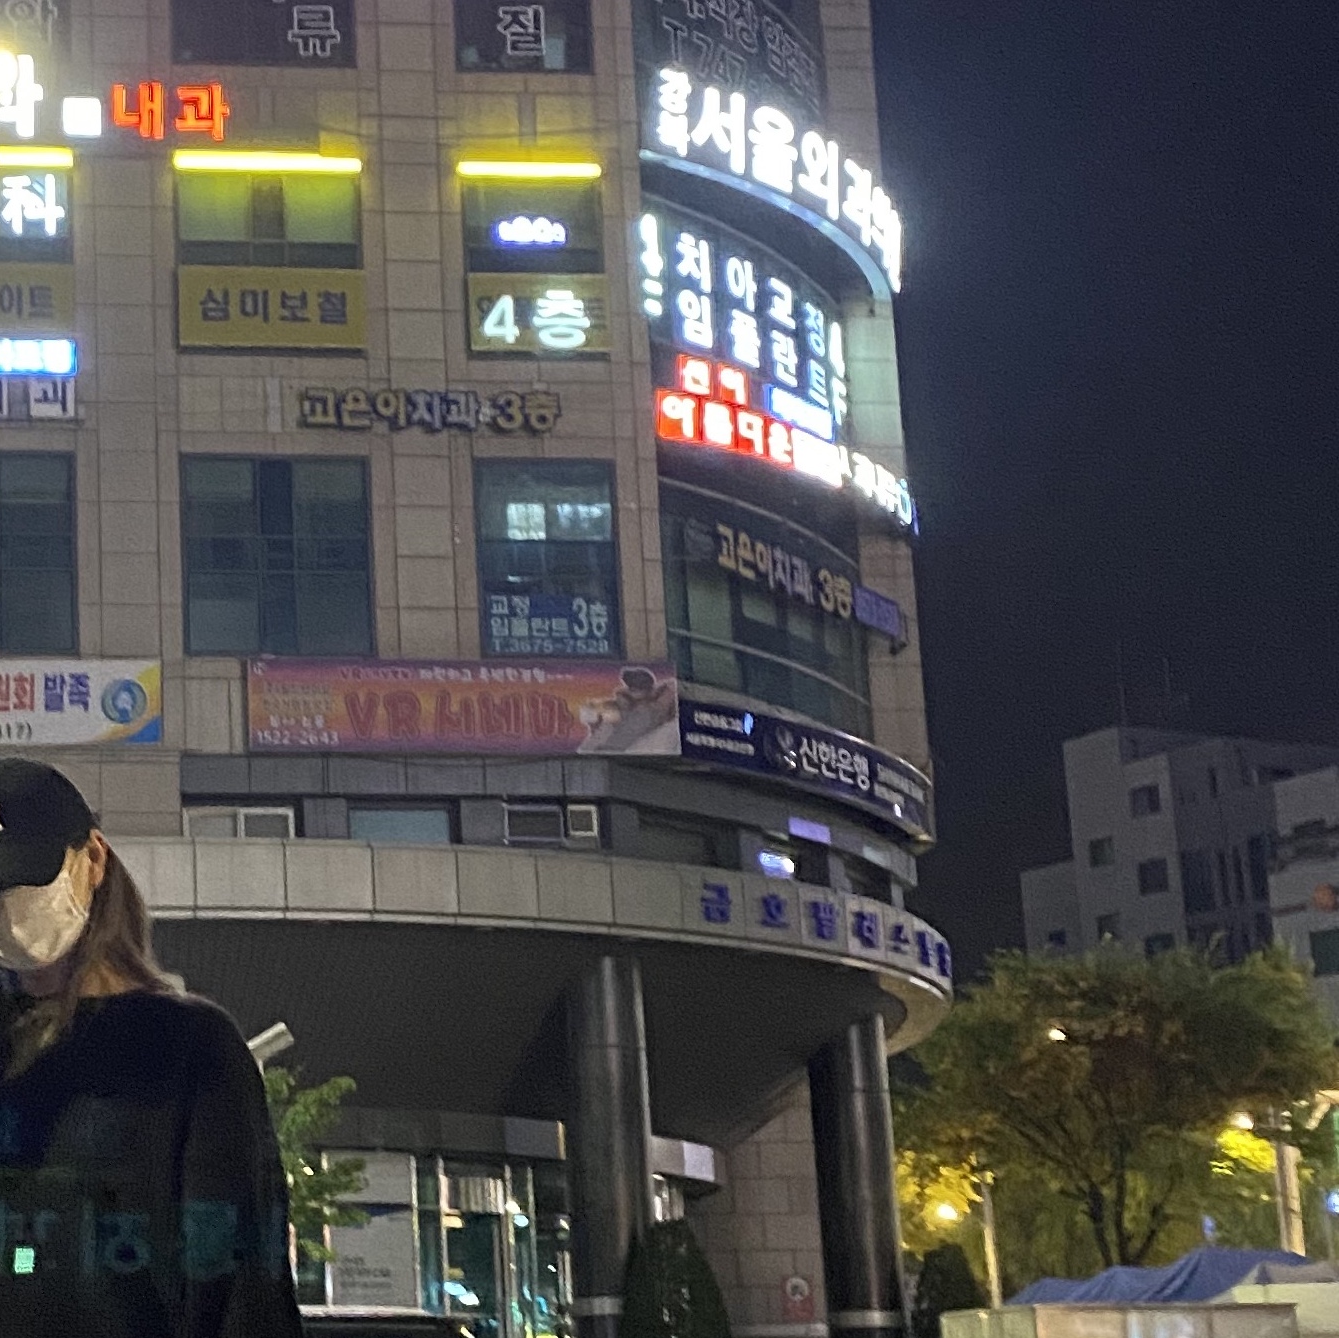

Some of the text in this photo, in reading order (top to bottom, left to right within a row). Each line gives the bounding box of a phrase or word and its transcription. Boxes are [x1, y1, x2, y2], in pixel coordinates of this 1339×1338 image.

[112, 82, 229, 140] 내과
[483, 289, 590, 349] 4층
[345, 691, 419, 741] VR
[799, 736, 870, 791] 신한은행
